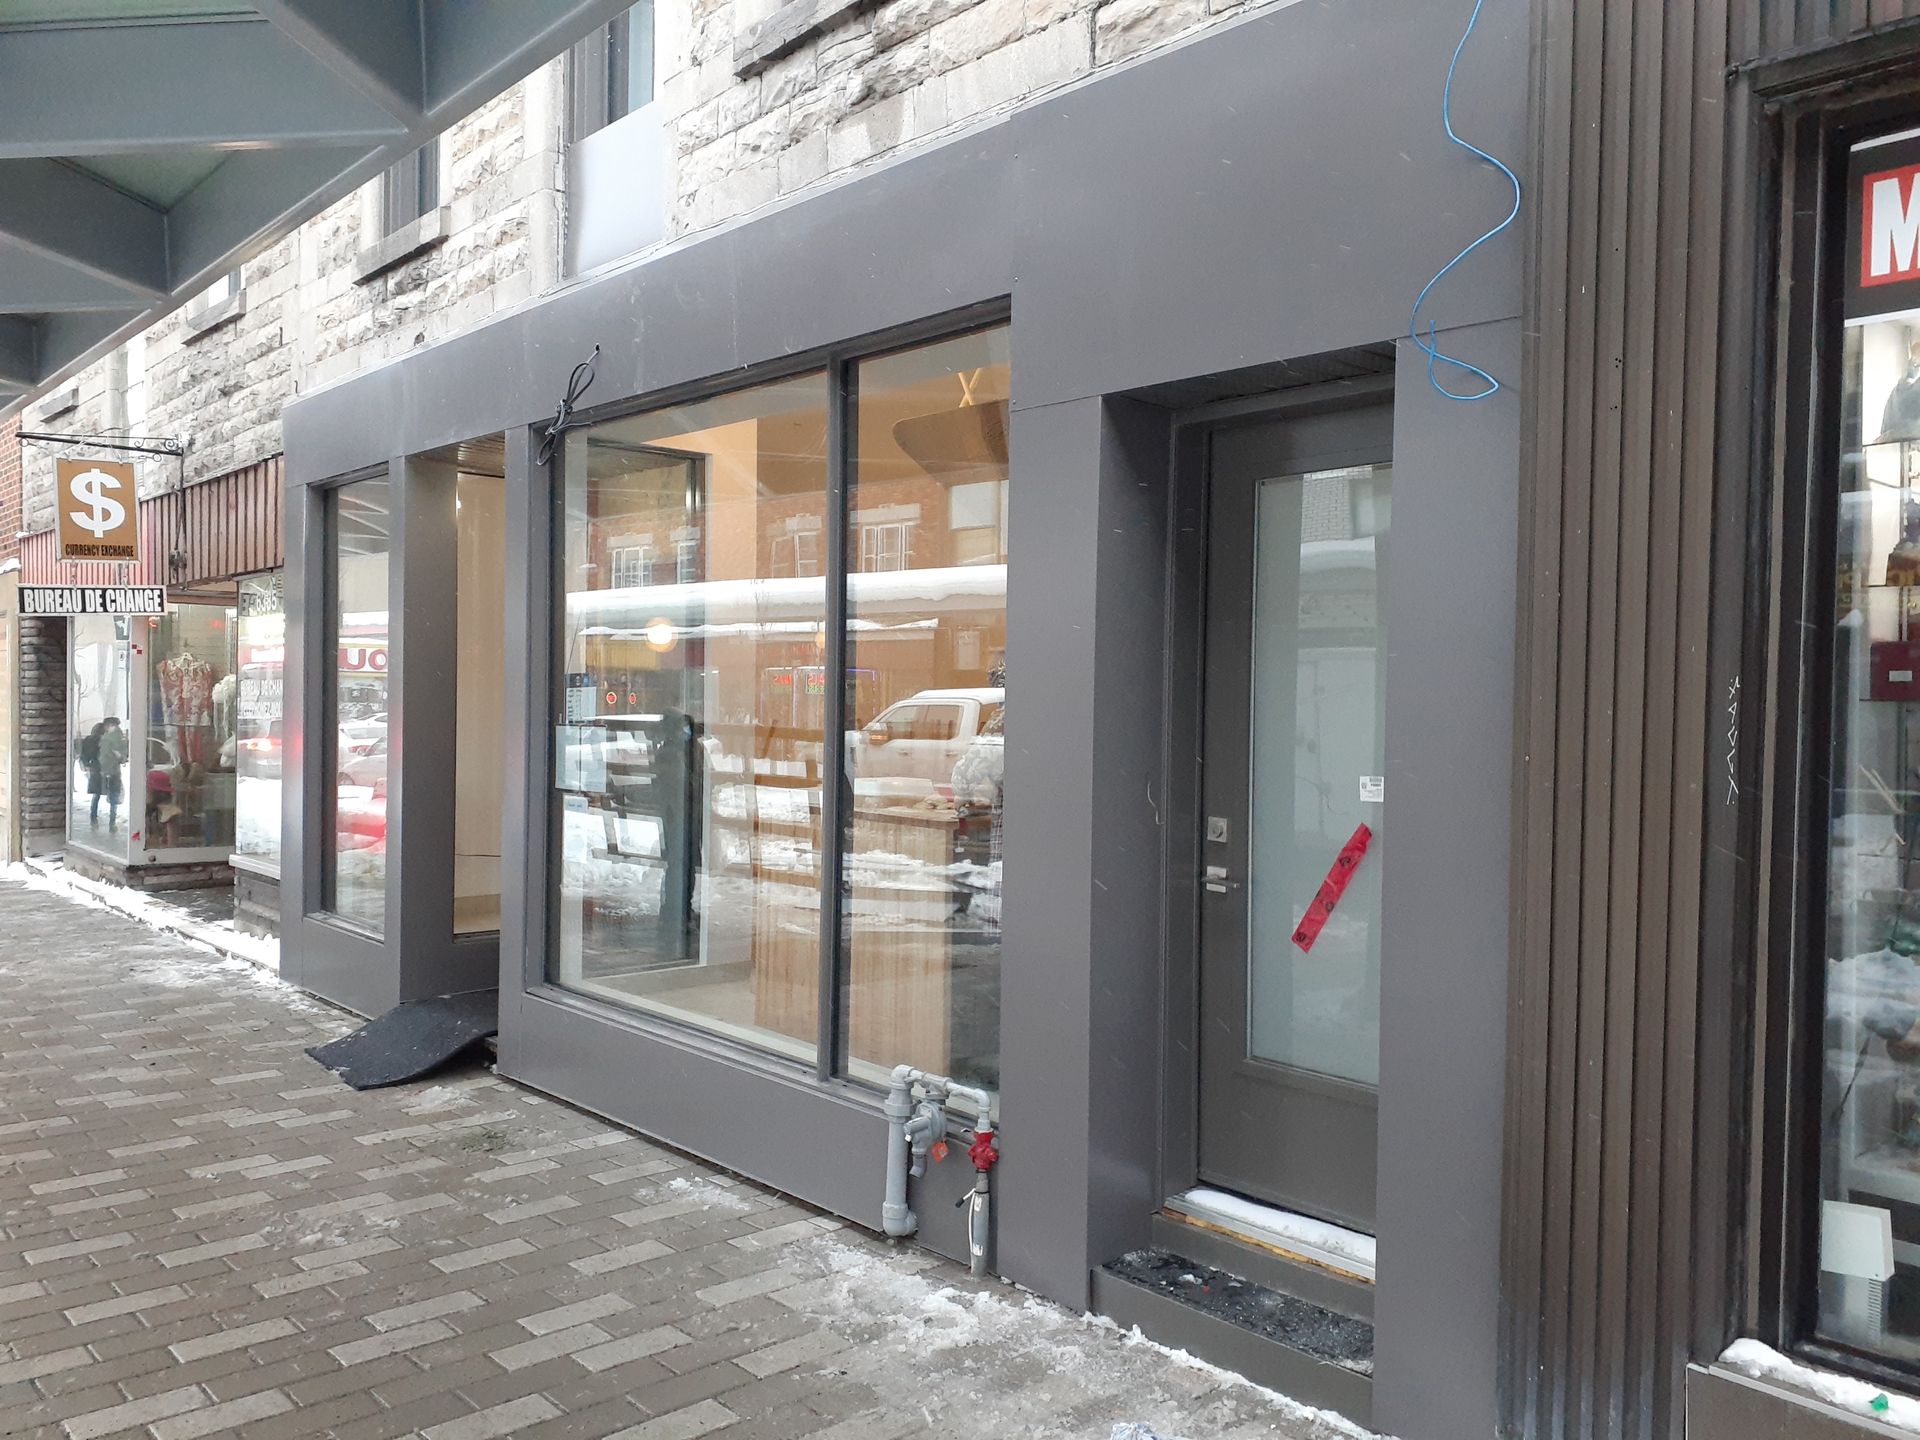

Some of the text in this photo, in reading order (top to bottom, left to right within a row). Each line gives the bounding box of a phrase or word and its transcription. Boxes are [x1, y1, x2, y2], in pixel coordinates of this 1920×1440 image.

[65, 544, 134, 557] CURRENCY EXCHANGE
[24, 589, 161, 613] BUREAU DE CHANGE
